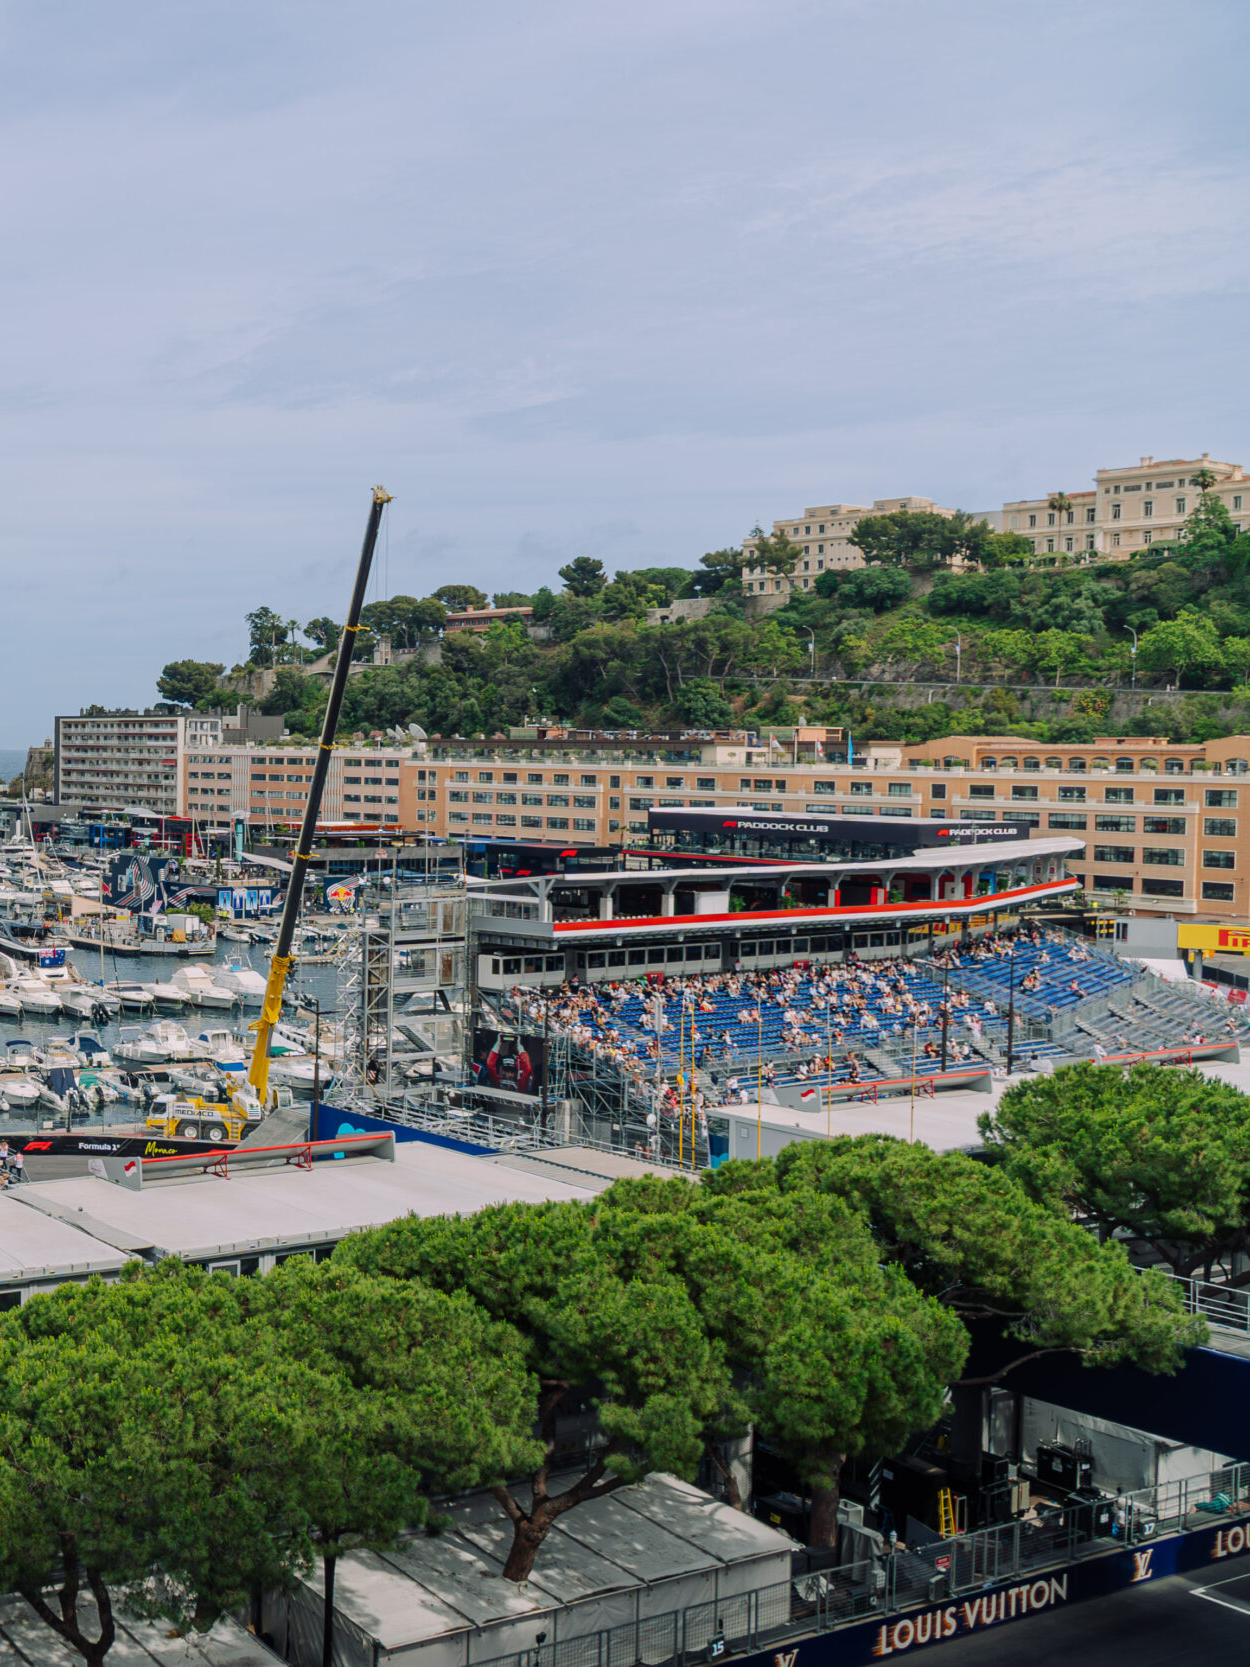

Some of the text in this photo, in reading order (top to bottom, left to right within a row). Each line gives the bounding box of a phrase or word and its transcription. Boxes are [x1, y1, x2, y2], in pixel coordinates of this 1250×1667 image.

[737, 821, 795, 831] PADDOCK
[795, 824, 829, 833] CLUB
[78, 1142, 111, 1151] Formula
[144, 1141, 178, 1157] Monaco
[1143, 1522, 1156, 1536] 17
[875, 1573, 1068, 1656] LOUIS VUITTON
[711, 1640, 725, 1657] 15
